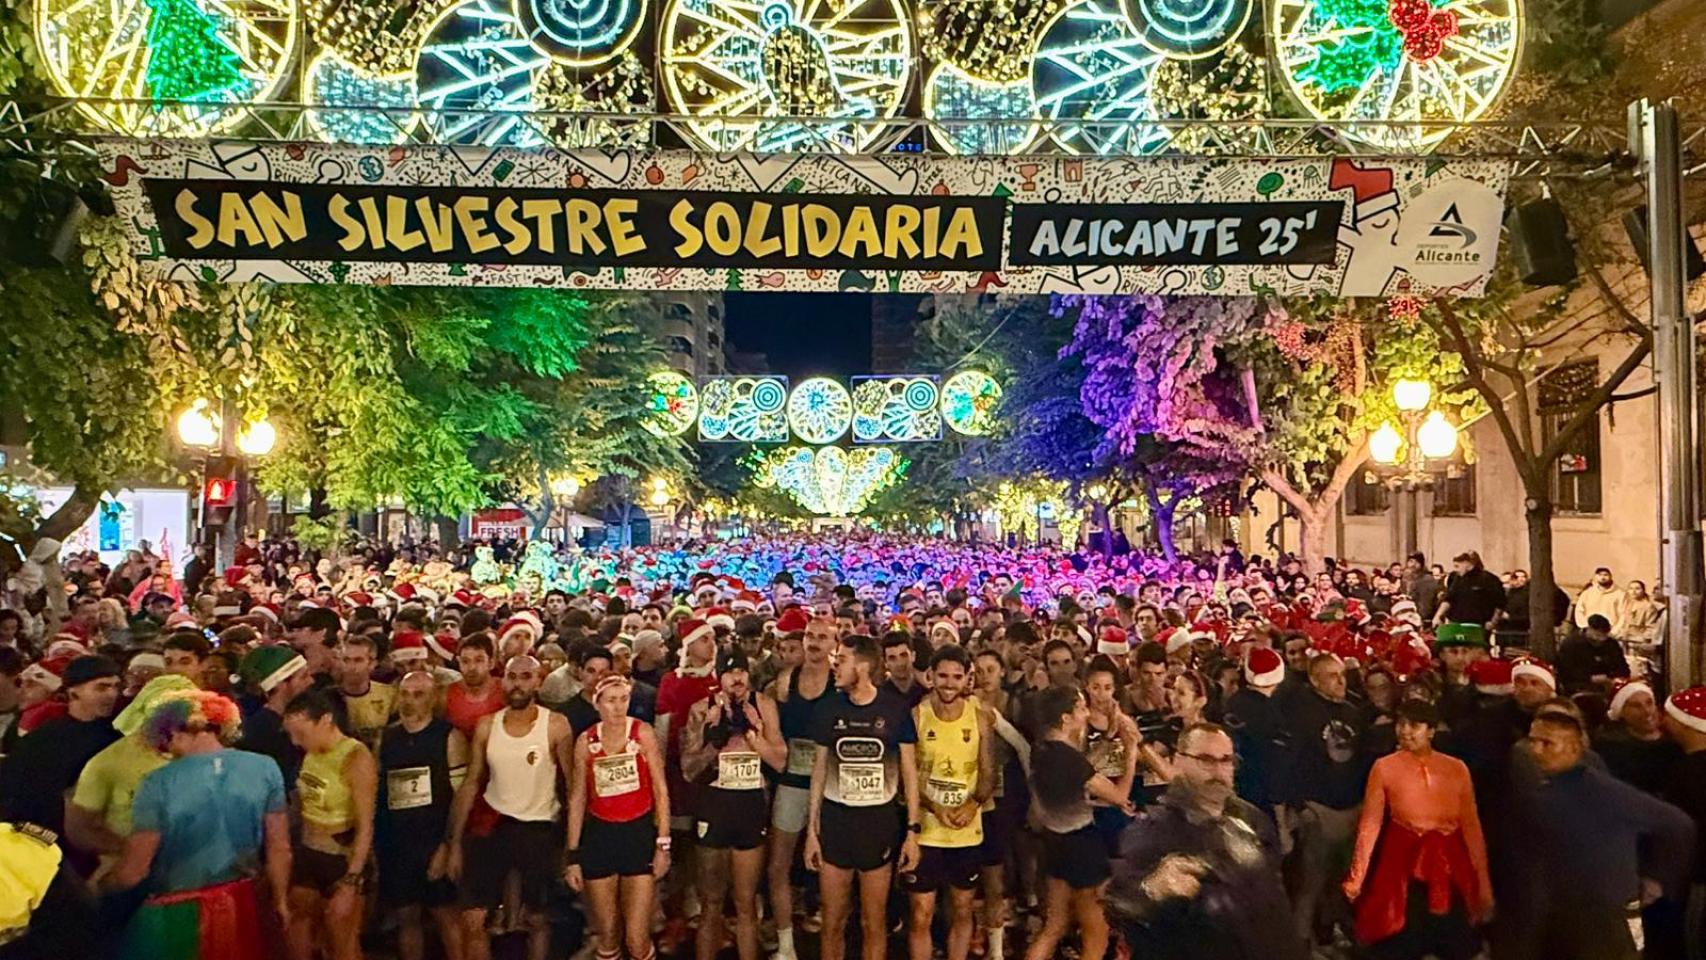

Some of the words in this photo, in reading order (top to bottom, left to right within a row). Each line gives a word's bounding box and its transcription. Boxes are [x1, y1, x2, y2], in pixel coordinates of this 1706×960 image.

[175, 188, 307, 249] SAN
[328, 192, 646, 257] SILVESTRE
[668, 198, 984, 259] SOLIDARIA
[1029, 218, 1242, 257] ALICANTE
[1258, 208, 1318, 256] 25'
[1415, 249, 1481, 262] Alicante
[608, 766, 636, 781] 2804
[734, 764, 758, 777] 1707
[411, 780, 418, 793] 2
[857, 777, 881, 790] 1047
[943, 792, 963, 804] 835
